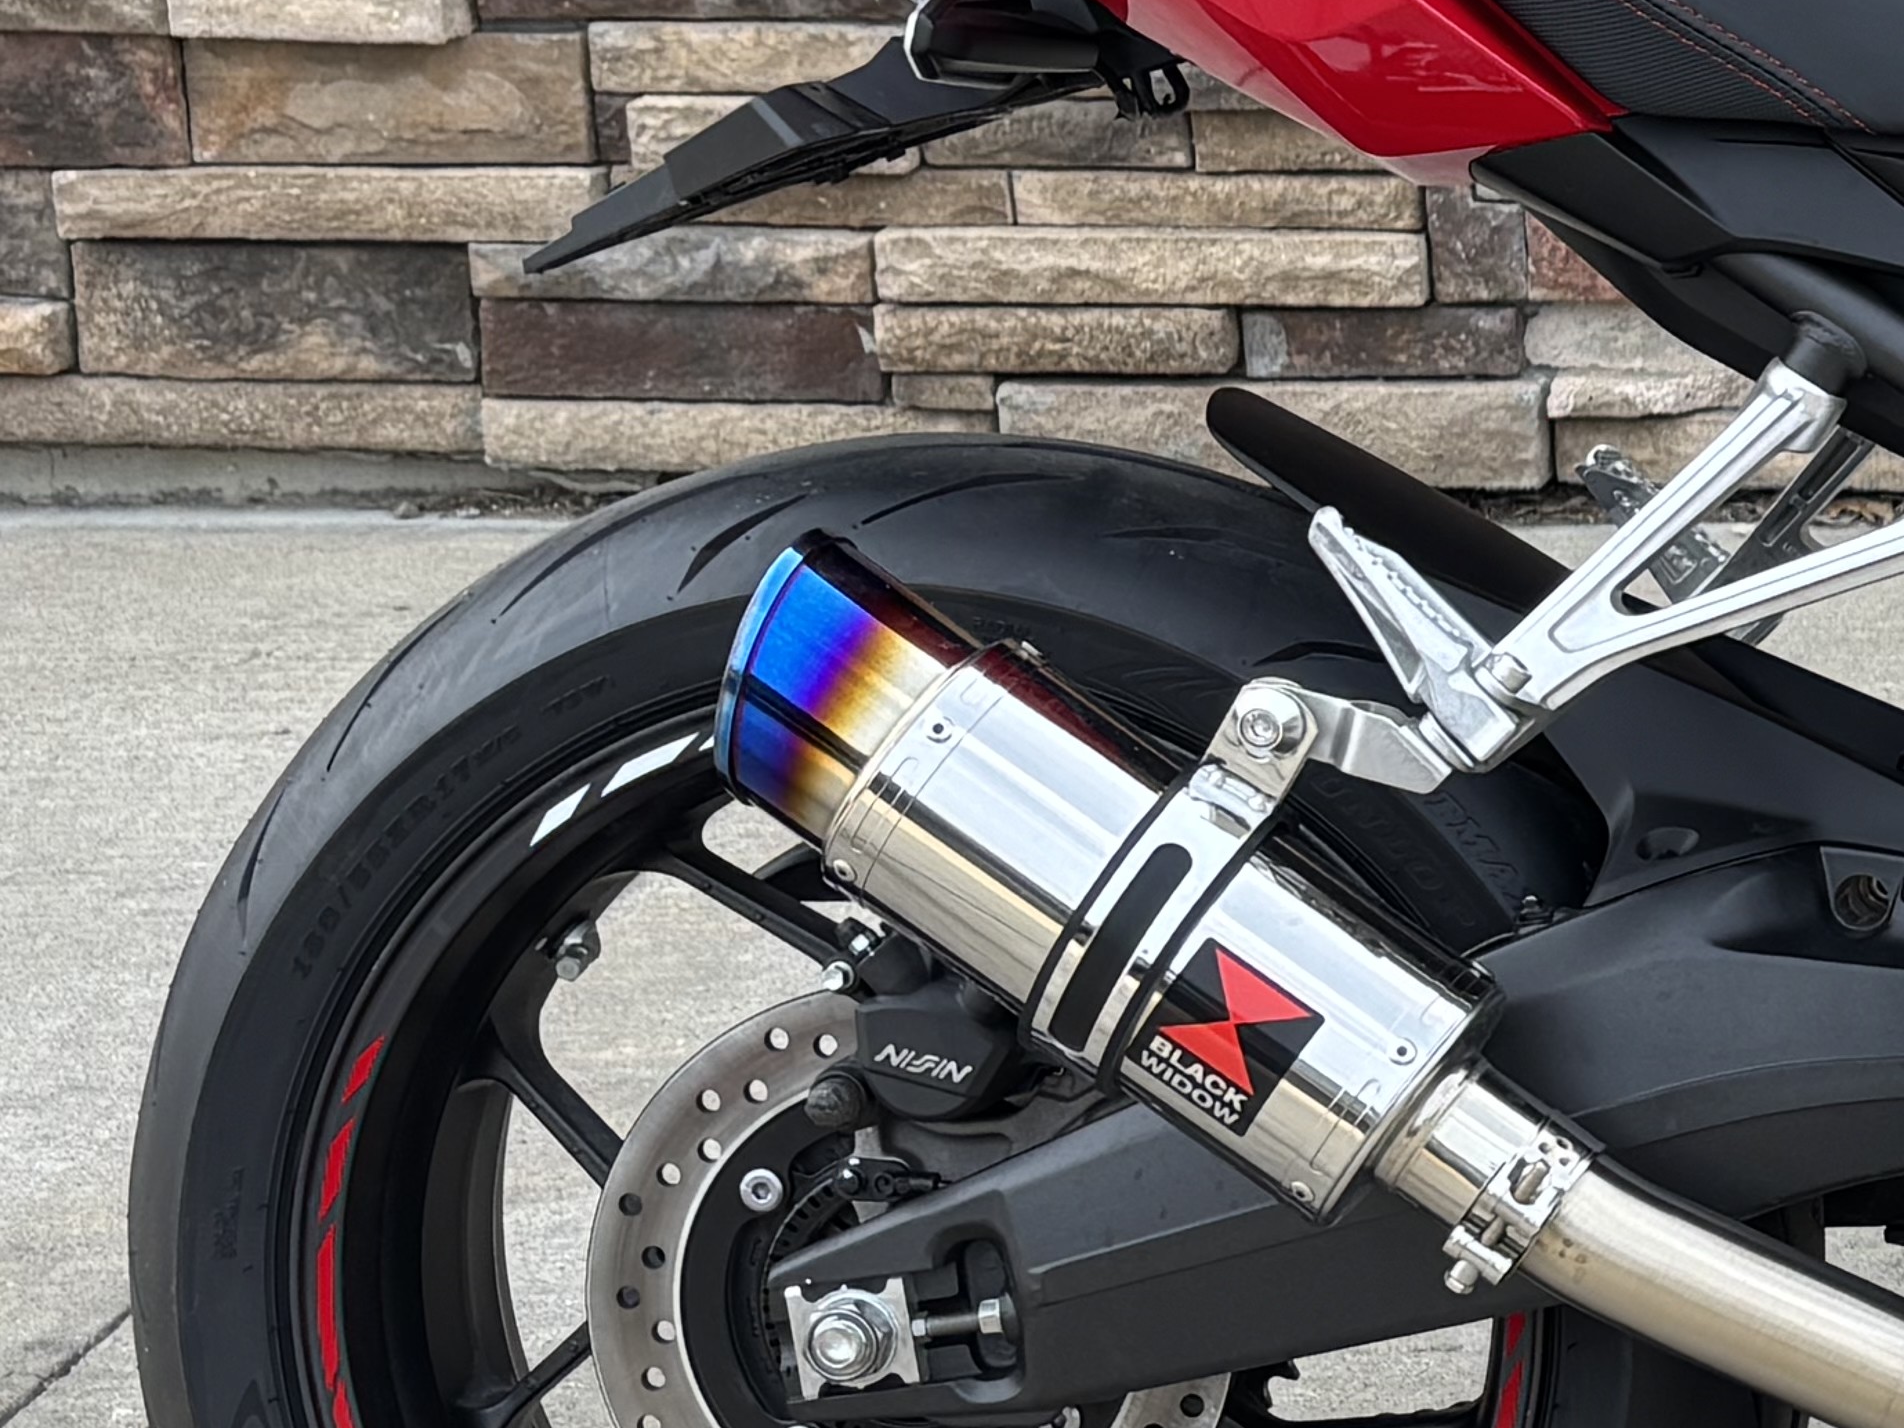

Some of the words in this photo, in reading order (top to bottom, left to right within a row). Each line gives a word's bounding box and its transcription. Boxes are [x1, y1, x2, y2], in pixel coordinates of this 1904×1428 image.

[874, 1043, 973, 1083] NISSIN
[1141, 1050, 1240, 1125] WIDOW
[1149, 1035, 1248, 1112] BLACK
